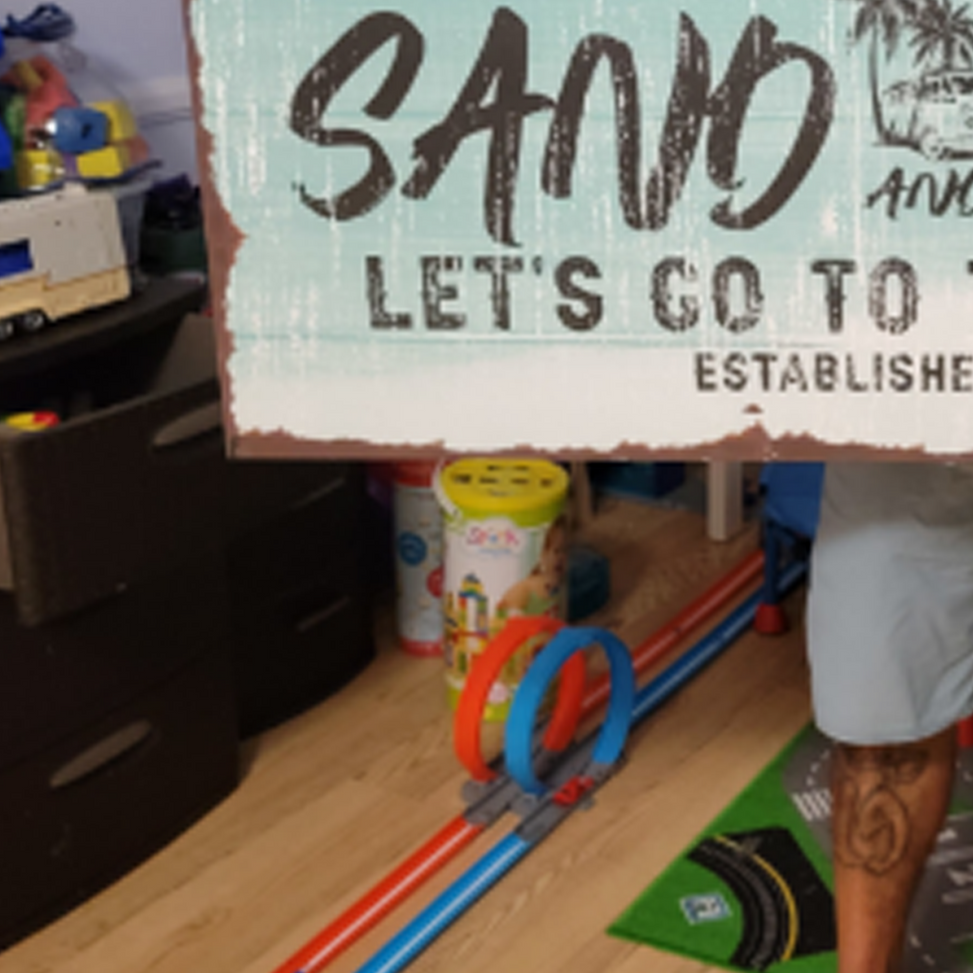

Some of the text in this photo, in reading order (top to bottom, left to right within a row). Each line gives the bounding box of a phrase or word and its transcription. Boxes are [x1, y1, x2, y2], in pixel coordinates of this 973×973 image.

[289, 5, 837, 248] SAND
[364, 254, 604, 333] LET'S
[649, 255, 765, 334] GO
[810, 257, 921, 335] TO
